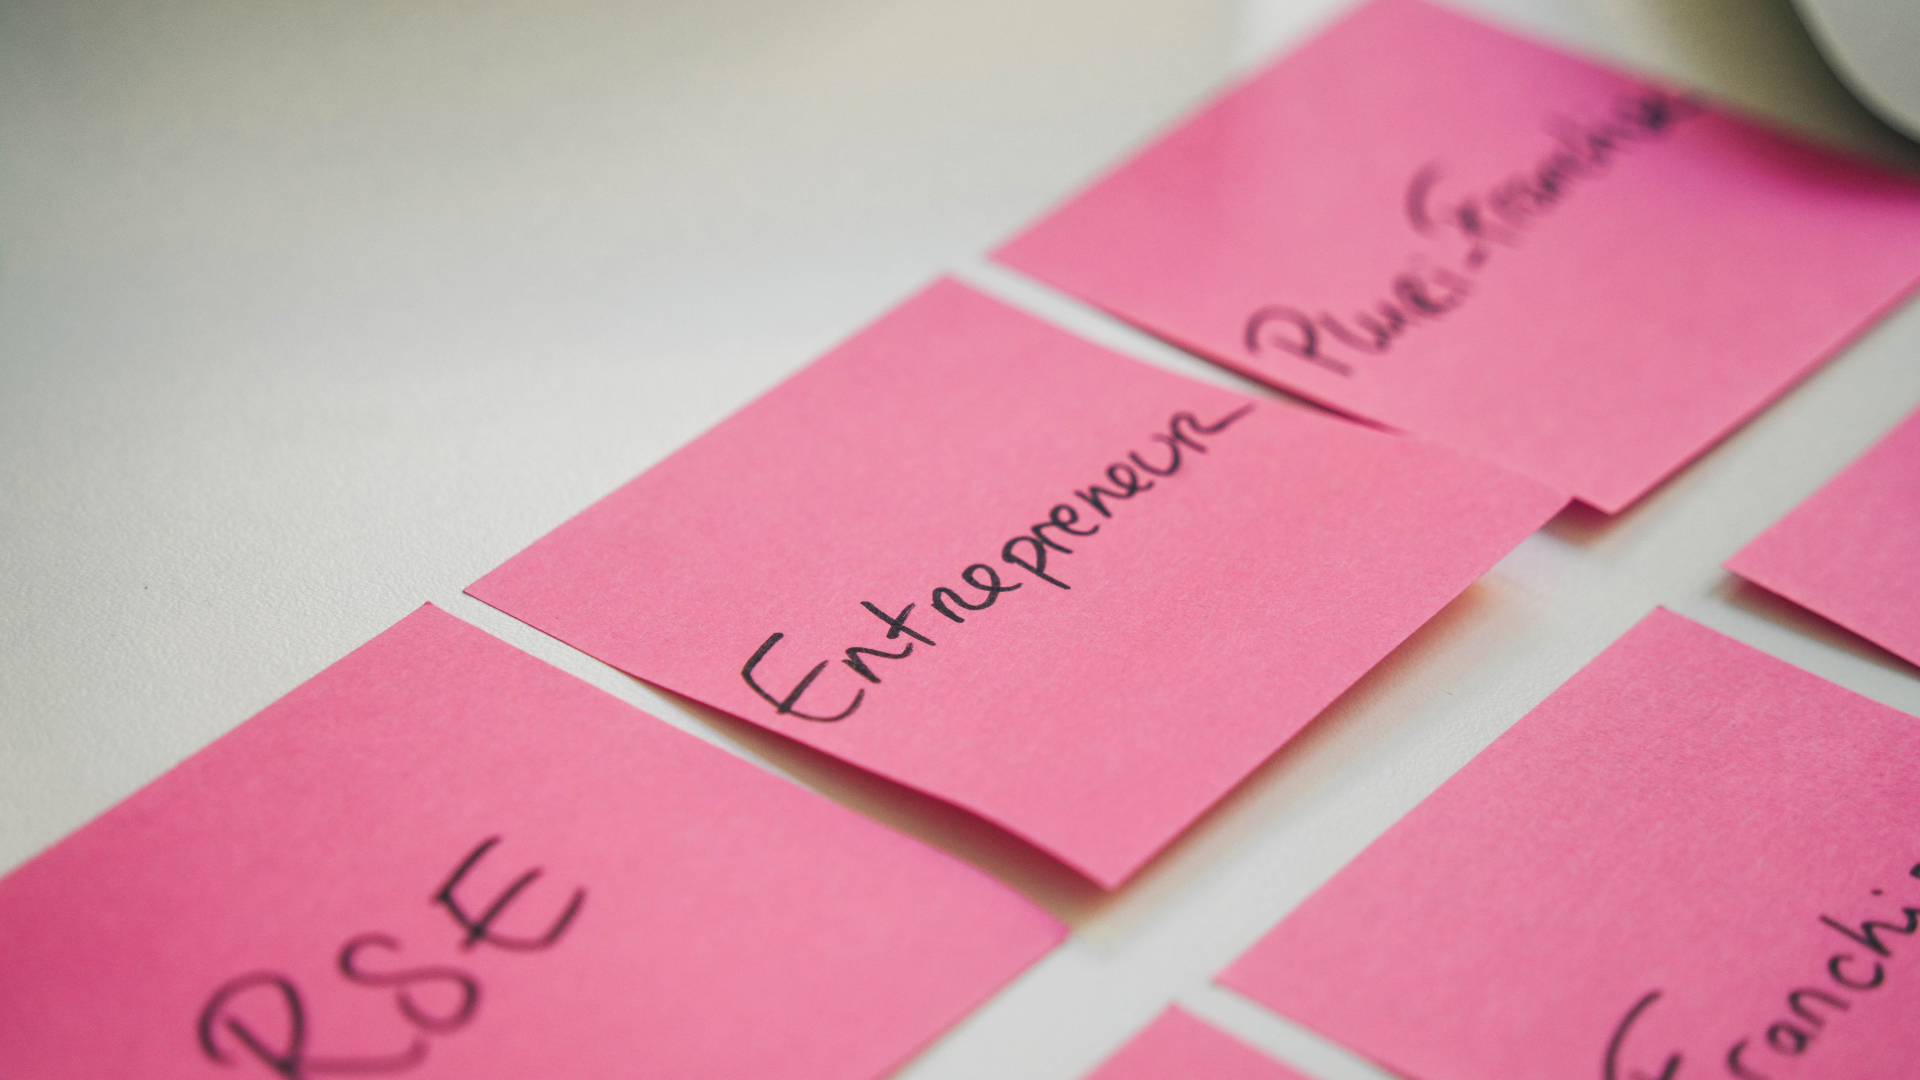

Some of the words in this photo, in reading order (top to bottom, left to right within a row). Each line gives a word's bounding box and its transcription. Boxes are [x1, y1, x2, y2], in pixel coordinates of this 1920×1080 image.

[741, 402, 1256, 722] Entrepreneur
[196, 834, 587, 1080] RSE
[1604, 862, 1920, 1080] Franchi
